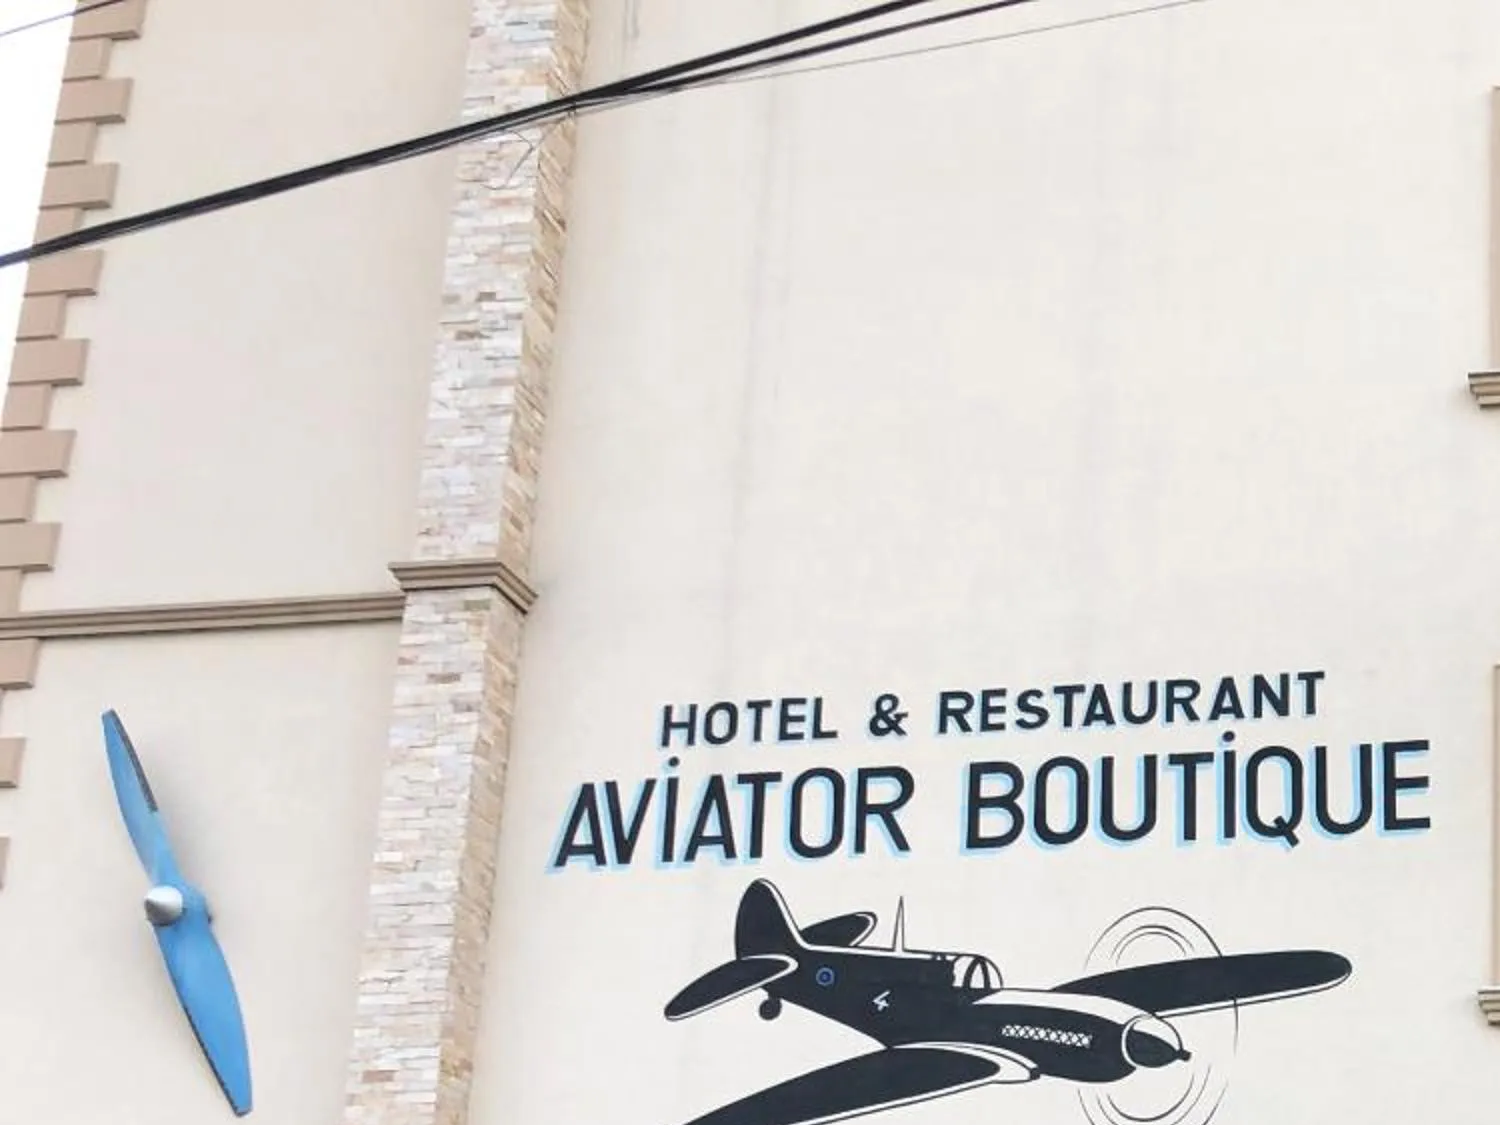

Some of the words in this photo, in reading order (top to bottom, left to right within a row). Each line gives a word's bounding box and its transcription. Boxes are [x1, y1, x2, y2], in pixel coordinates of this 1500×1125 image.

[660, 696, 838, 748] HOTEL
[868, 693, 909, 738] &
[937, 670, 1326, 735] RESTAURANT
